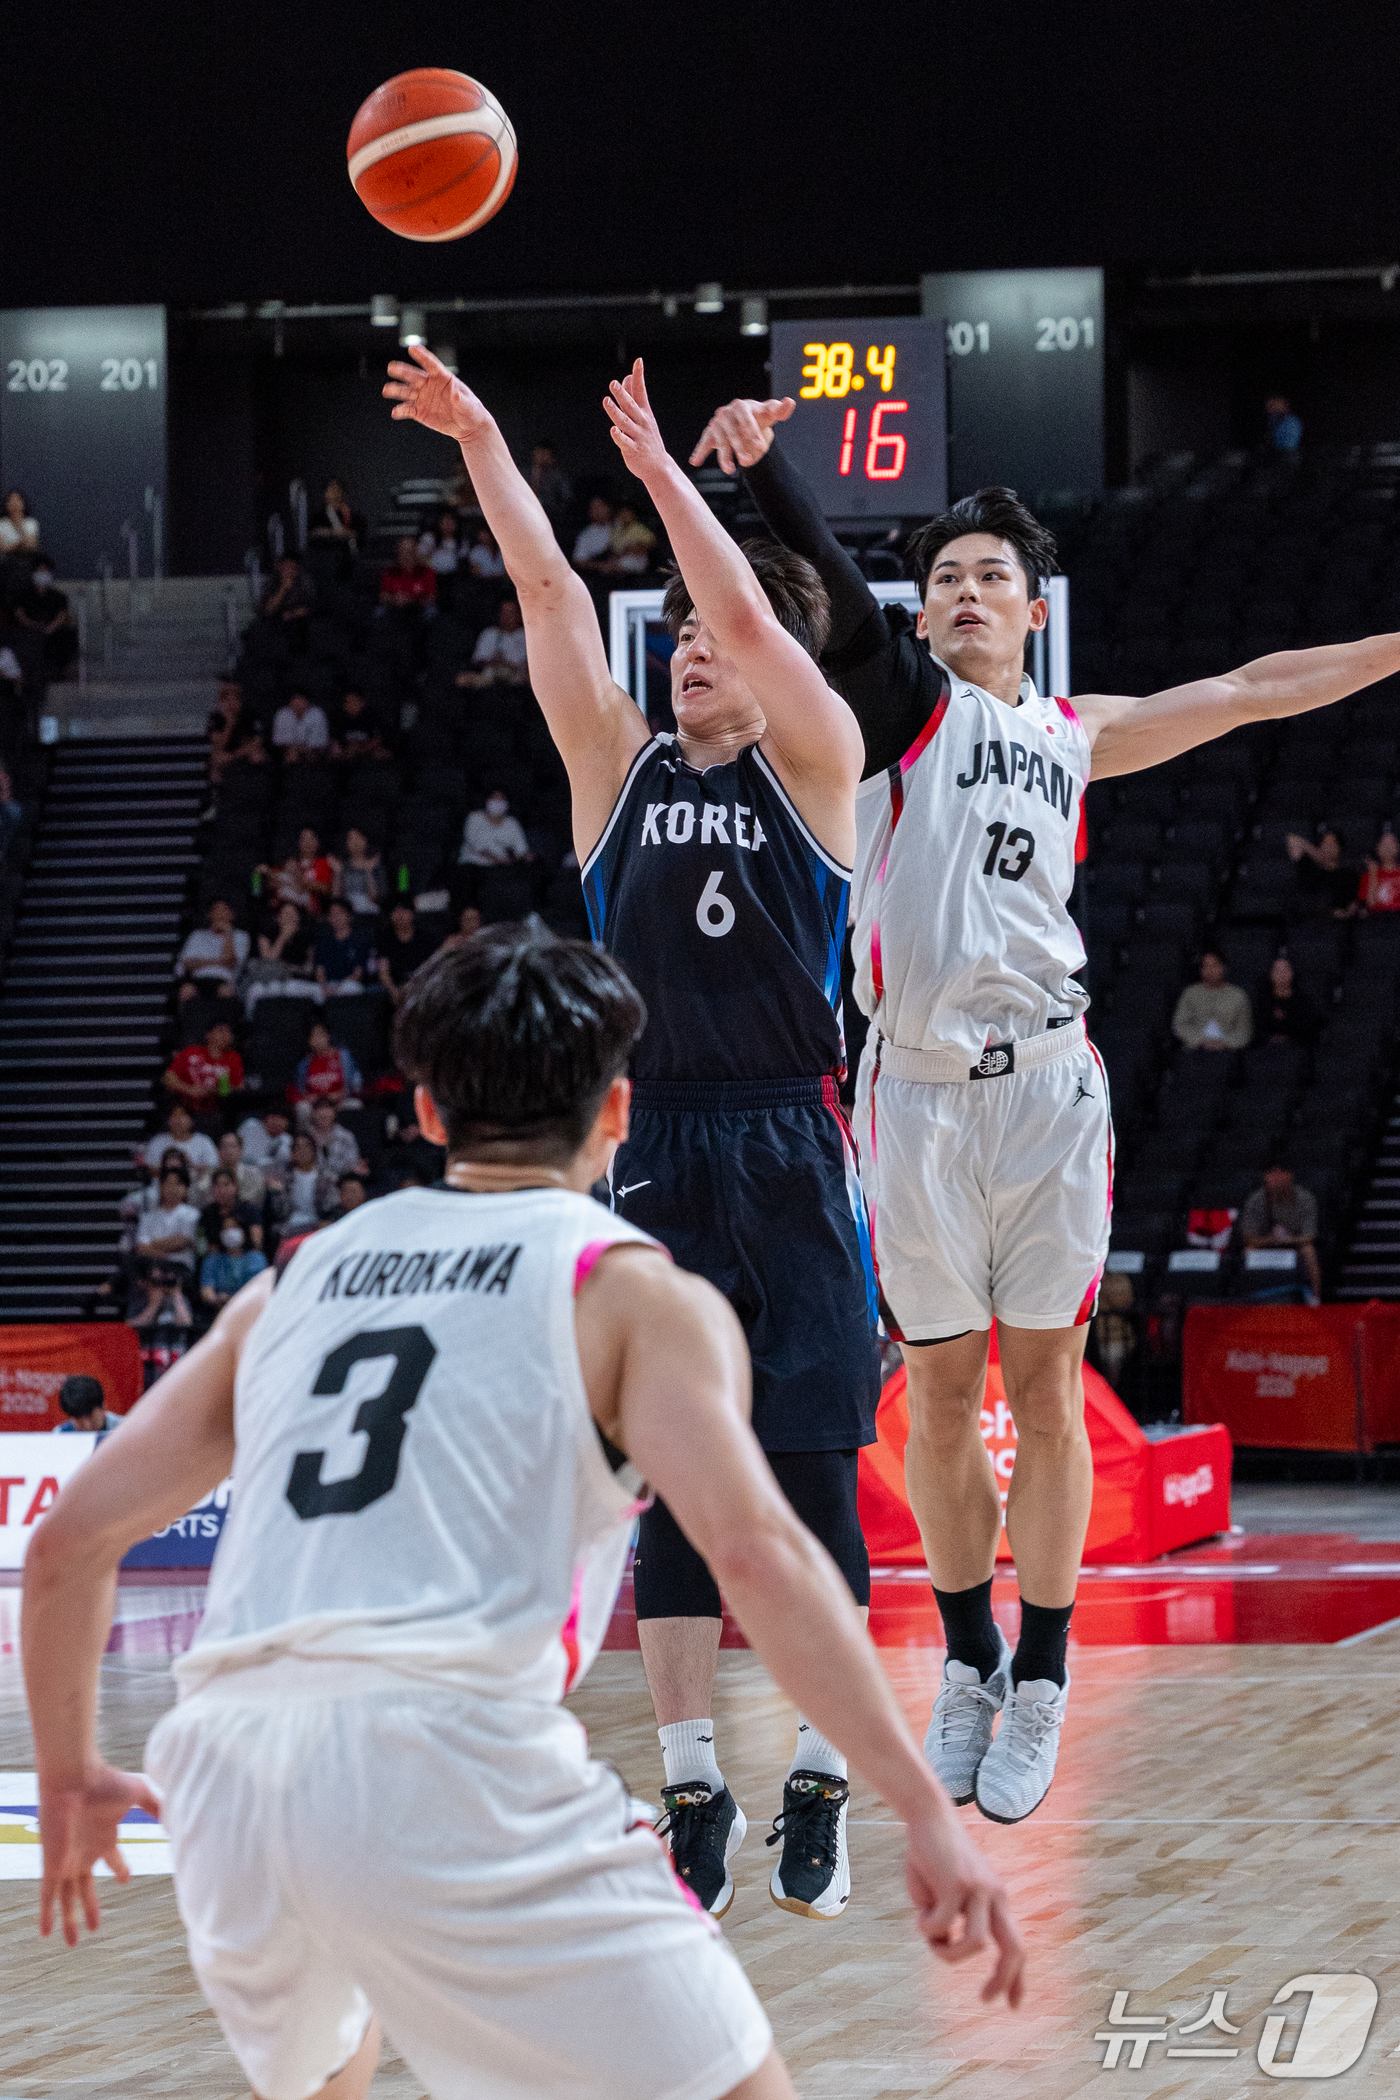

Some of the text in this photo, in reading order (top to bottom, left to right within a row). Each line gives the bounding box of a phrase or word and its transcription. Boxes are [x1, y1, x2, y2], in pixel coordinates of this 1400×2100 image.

[948, 316, 1095, 356] 01 201
[6, 357, 158, 392] 202 201
[800, 342, 896, 399] 38.4
[838, 400, 909, 481] 16
[956, 740, 1073, 822] JAPAN
[982, 820, 1036, 882] 13
[695, 870, 736, 938] 6
[317, 1242, 524, 1302] KUROKAWA
[285, 1324, 439, 1520] 3
